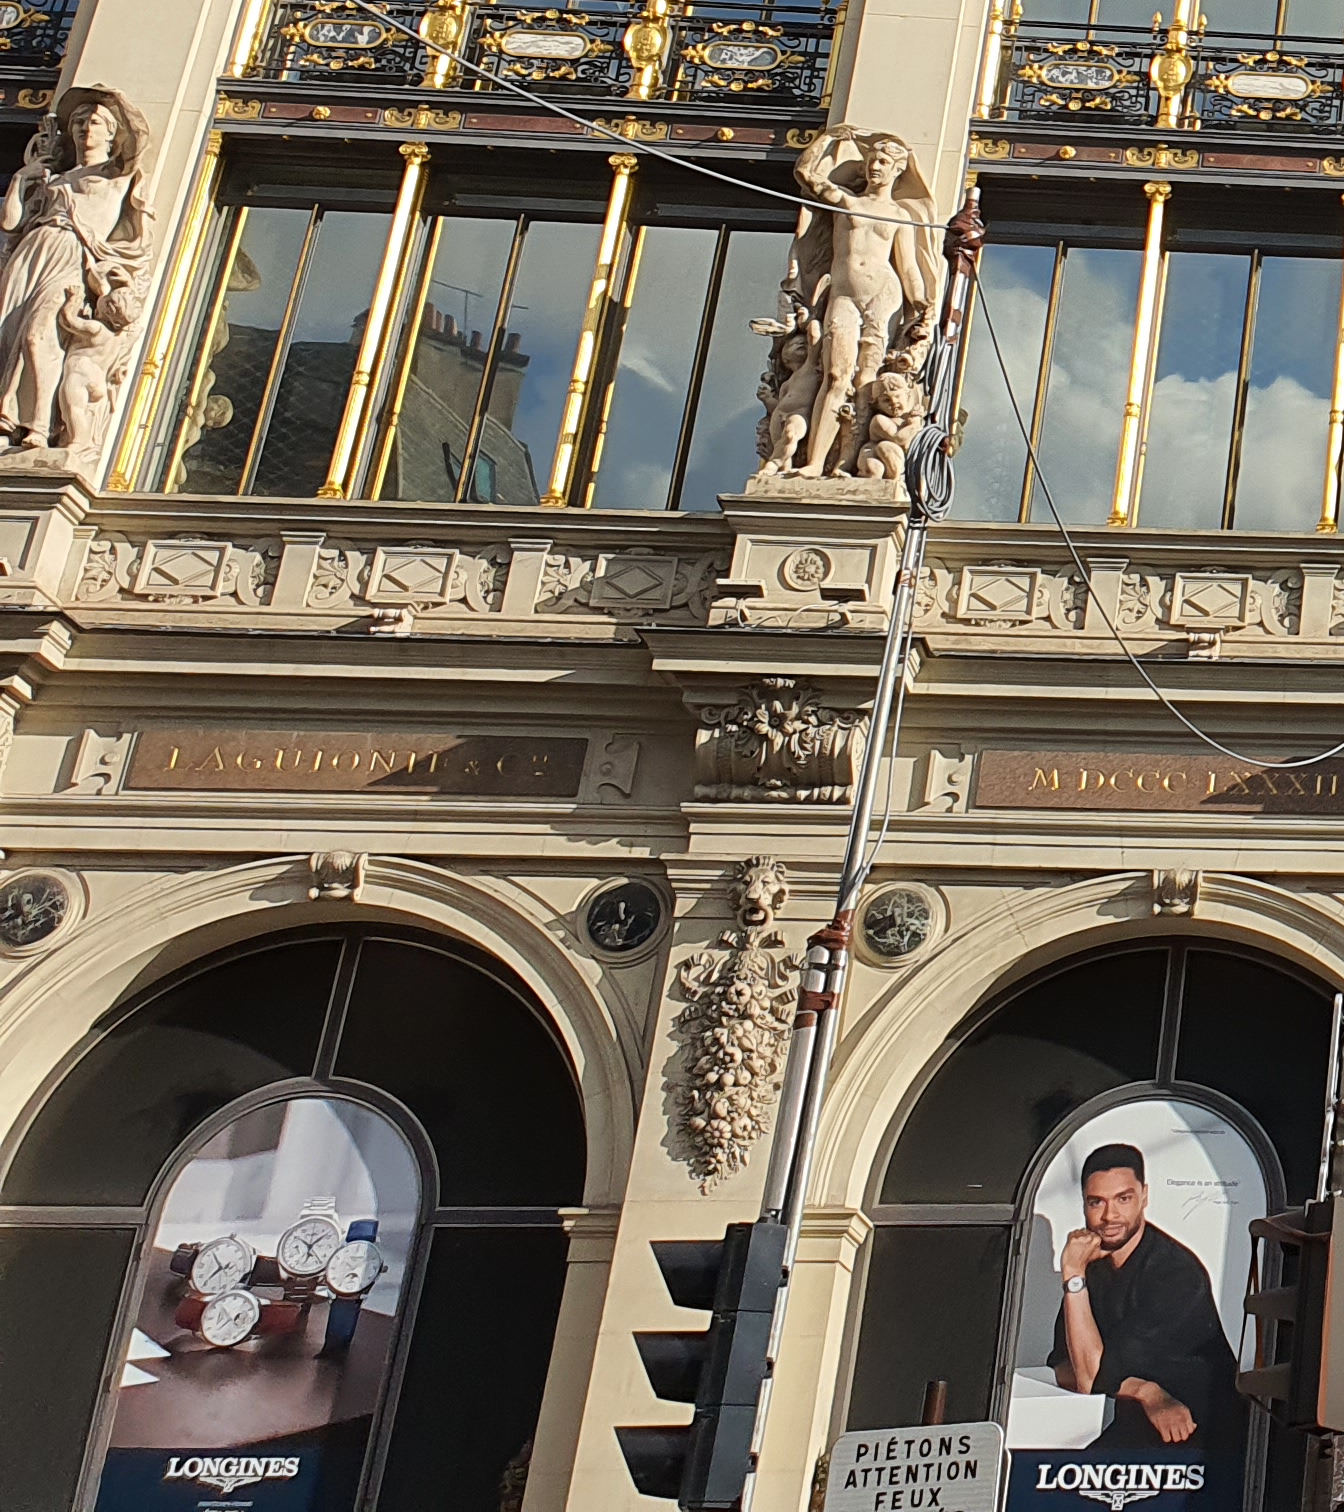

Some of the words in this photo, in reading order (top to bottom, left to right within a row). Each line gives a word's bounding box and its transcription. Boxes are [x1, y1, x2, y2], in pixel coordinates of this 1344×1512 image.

[854, 1435, 973, 1464] PIÉTONS
[164, 1456, 301, 1479] LONGINES
[844, 1460, 979, 1490] ATTENTION
[1035, 1463, 1205, 1491] LONGINES
[874, 1488, 942, 1512] FEUX
